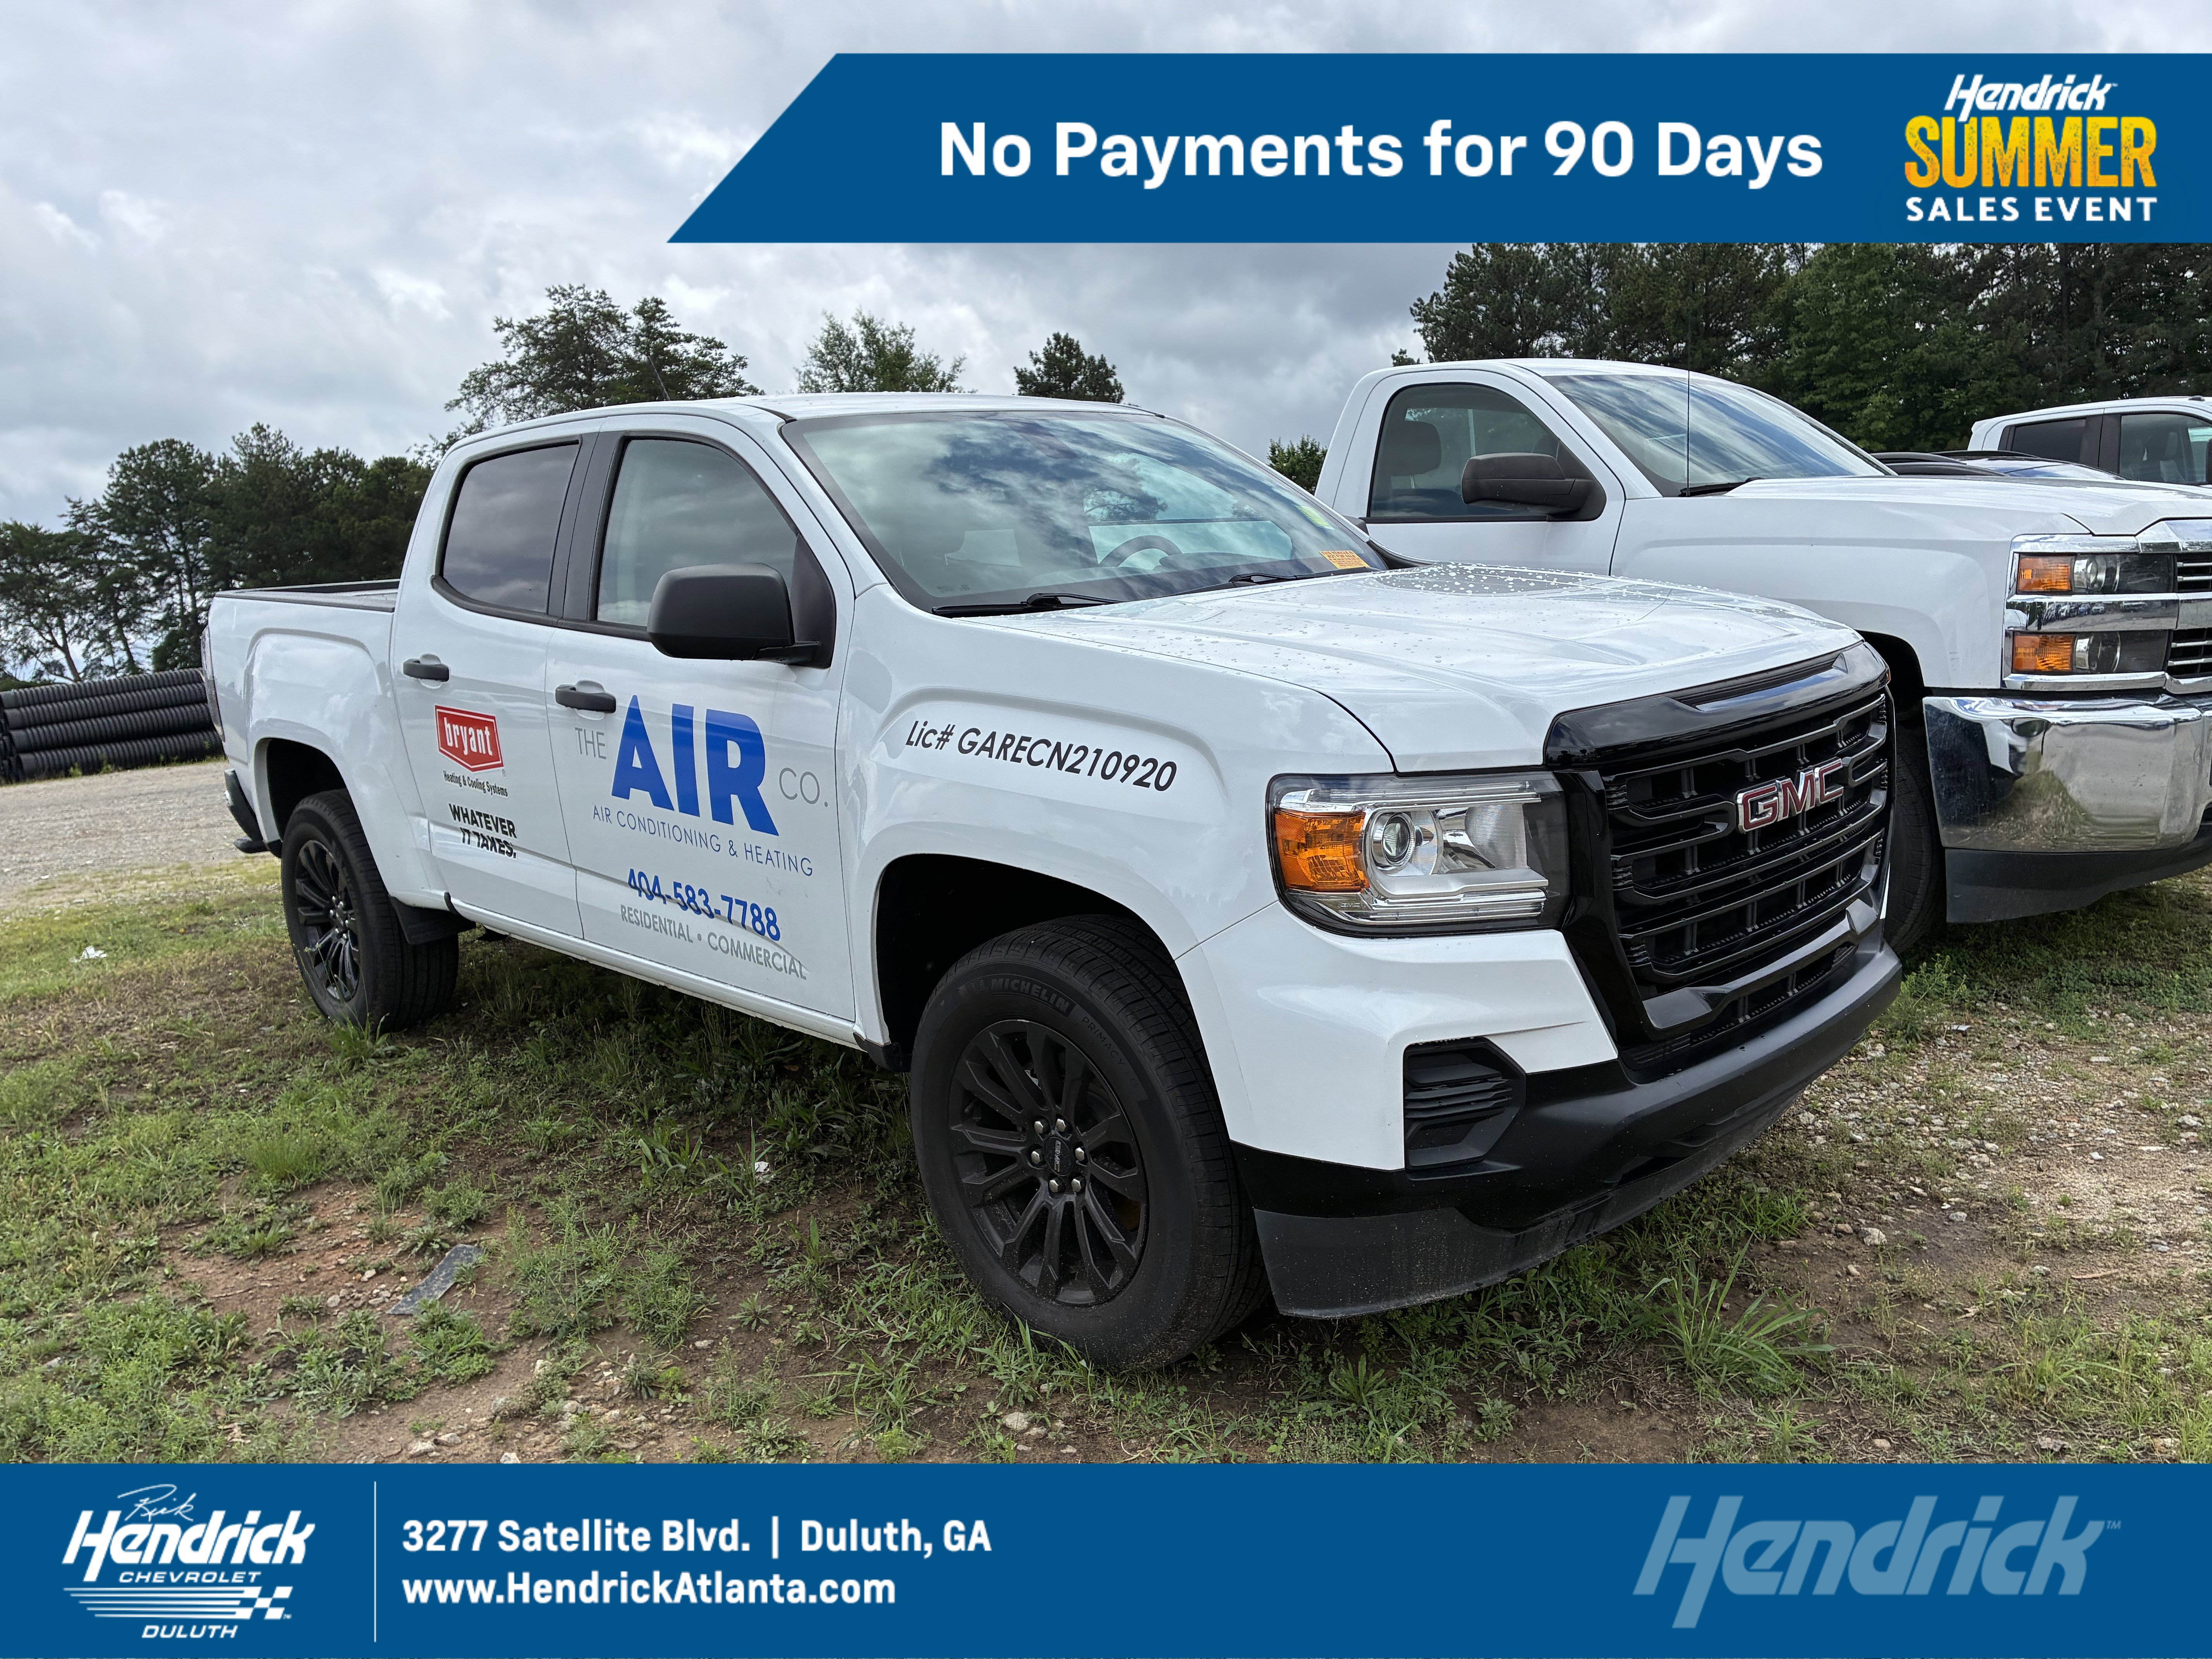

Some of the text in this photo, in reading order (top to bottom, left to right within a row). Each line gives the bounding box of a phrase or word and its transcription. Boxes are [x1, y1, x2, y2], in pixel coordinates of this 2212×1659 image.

[444, 717, 493, 756] bryant
[575, 696, 828, 836] THE AIR CO.
[906, 721, 1176, 791] Lic# GARECN210920
[443, 770, 508, 797] Heating & Cooling Systems
[1737, 758, 1844, 833] GMC
[449, 804, 517, 838] WHATEVER
[593, 805, 812, 876] AIR CONDITIONING & HEATING
[628, 869, 780, 941] 404-583-7788
[621, 904, 806, 980] RESIDENTIAL COMMERCIAL
[991, 978, 1070, 1013] MICHELIN
[1081, 1017, 1125, 1066] PRIMACY
